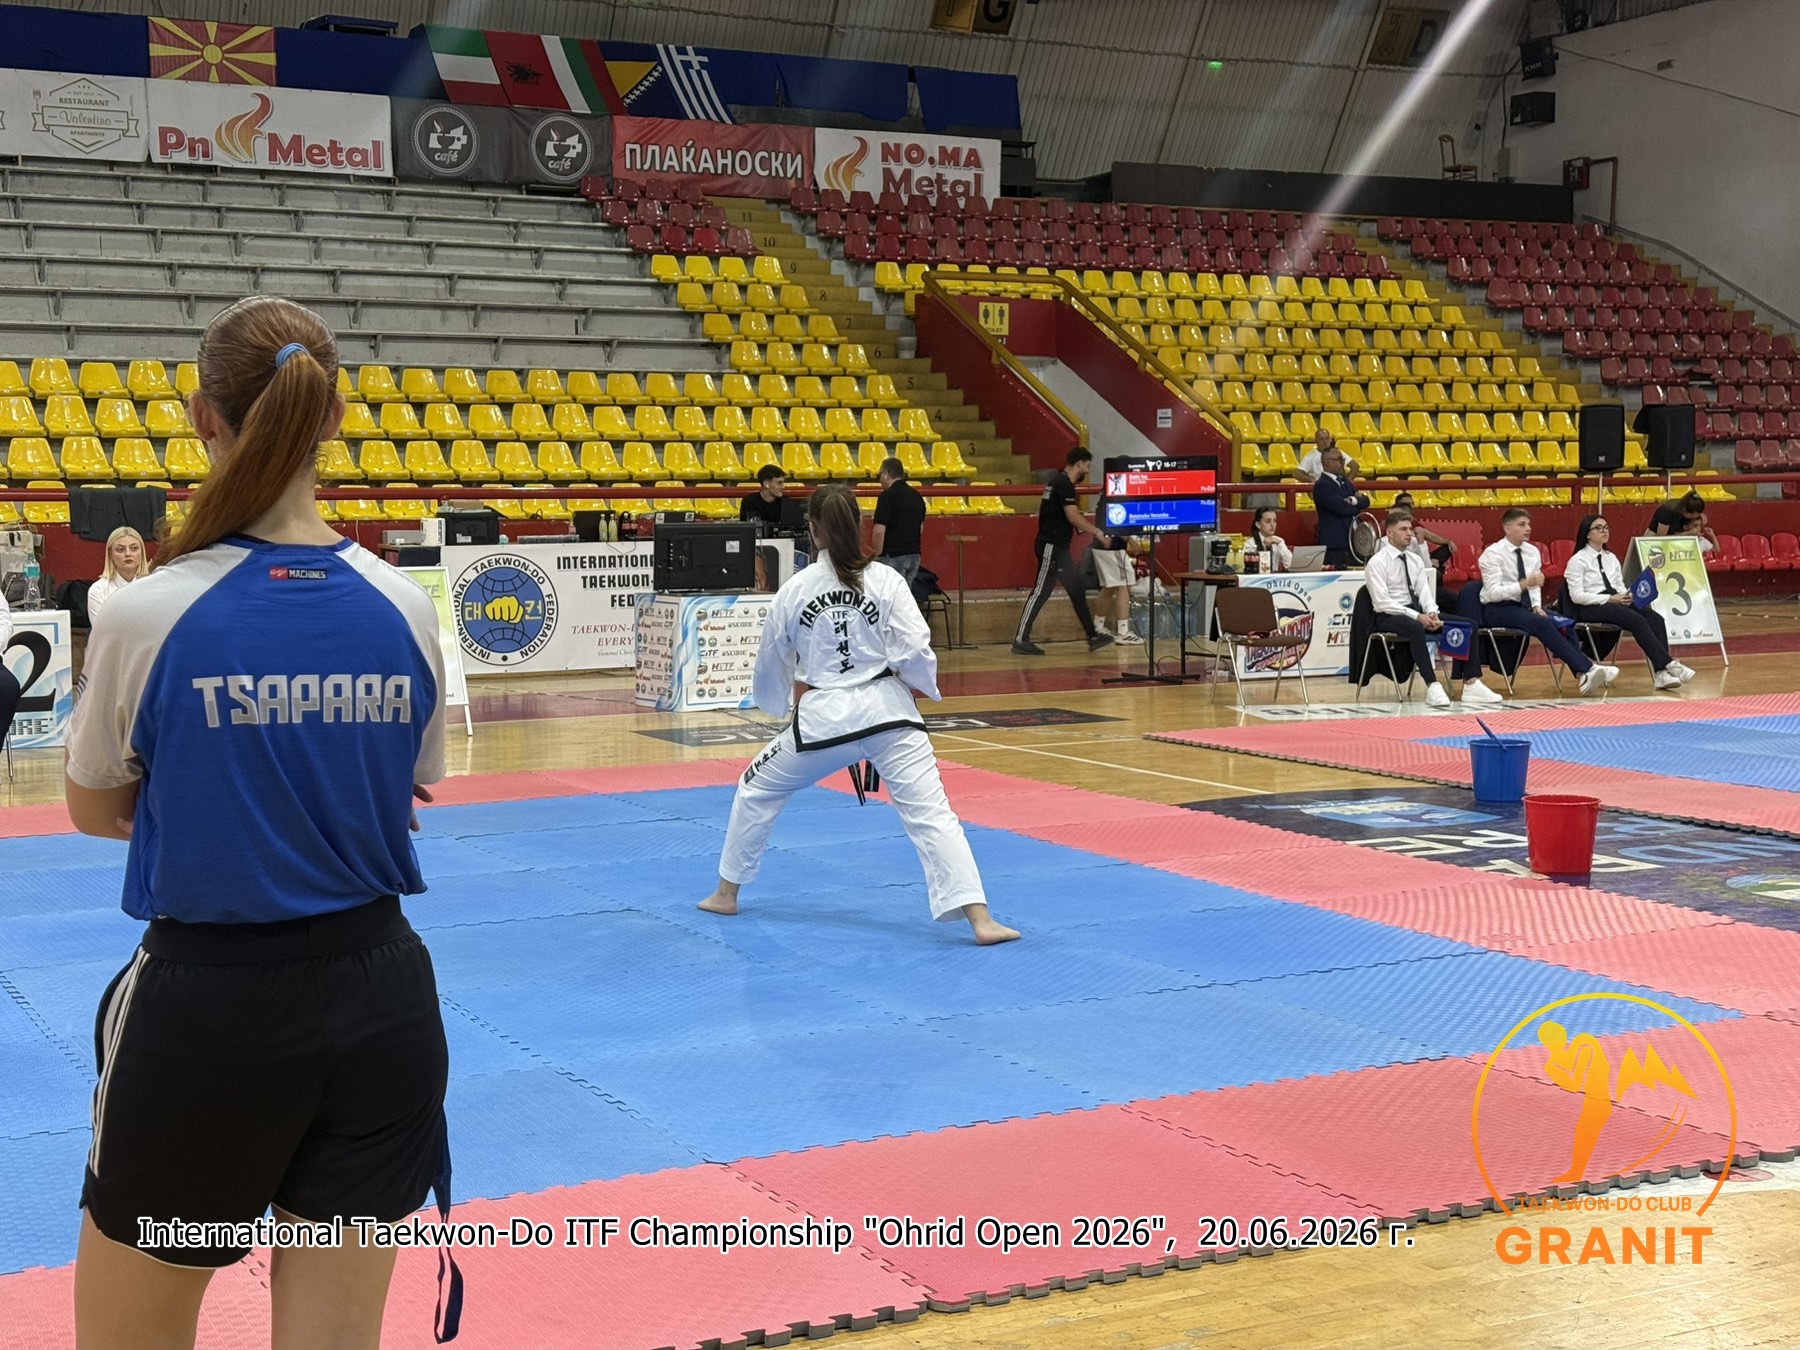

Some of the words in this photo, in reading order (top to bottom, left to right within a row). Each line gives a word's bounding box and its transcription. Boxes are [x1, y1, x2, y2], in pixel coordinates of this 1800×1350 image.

[58, 96, 110, 107] RESTAURANT
[59, 110, 112, 126] Valentino
[157, 125, 211, 160] Pn
[267, 132, 384, 171] Metal
[434, 150, 459, 164] café
[624, 139, 803, 180] ПЛАЌАНОСКИ
[880, 141, 984, 171] NO.MA
[547, 158, 572, 172] café
[881, 166, 984, 198] Metal
[741, 212, 752, 222] 11
[763, 237, 776, 247] 10
[790, 262, 797, 274] 9
[819, 289, 827, 301] 8
[874, 346, 882, 358] 6
[907, 377, 914, 389] 5
[934, 409, 942, 421] 4
[968, 442, 976, 456] 3
[288, 569, 327, 579] MACHINES
[1266, 579, 1292, 590] Ohrid
[1293, 582, 1312, 603] Open
[1665, 571, 1693, 616] 3
[471, 556, 546, 586] TAEKWON-DO
[519, 593, 556, 659] FEDERATION
[799, 590, 880, 628] TAEKWON-DO
[832, 610, 848, 620] ITF
[2, 630, 57, 713] 2
[192, 673, 412, 728] TSAPARA
